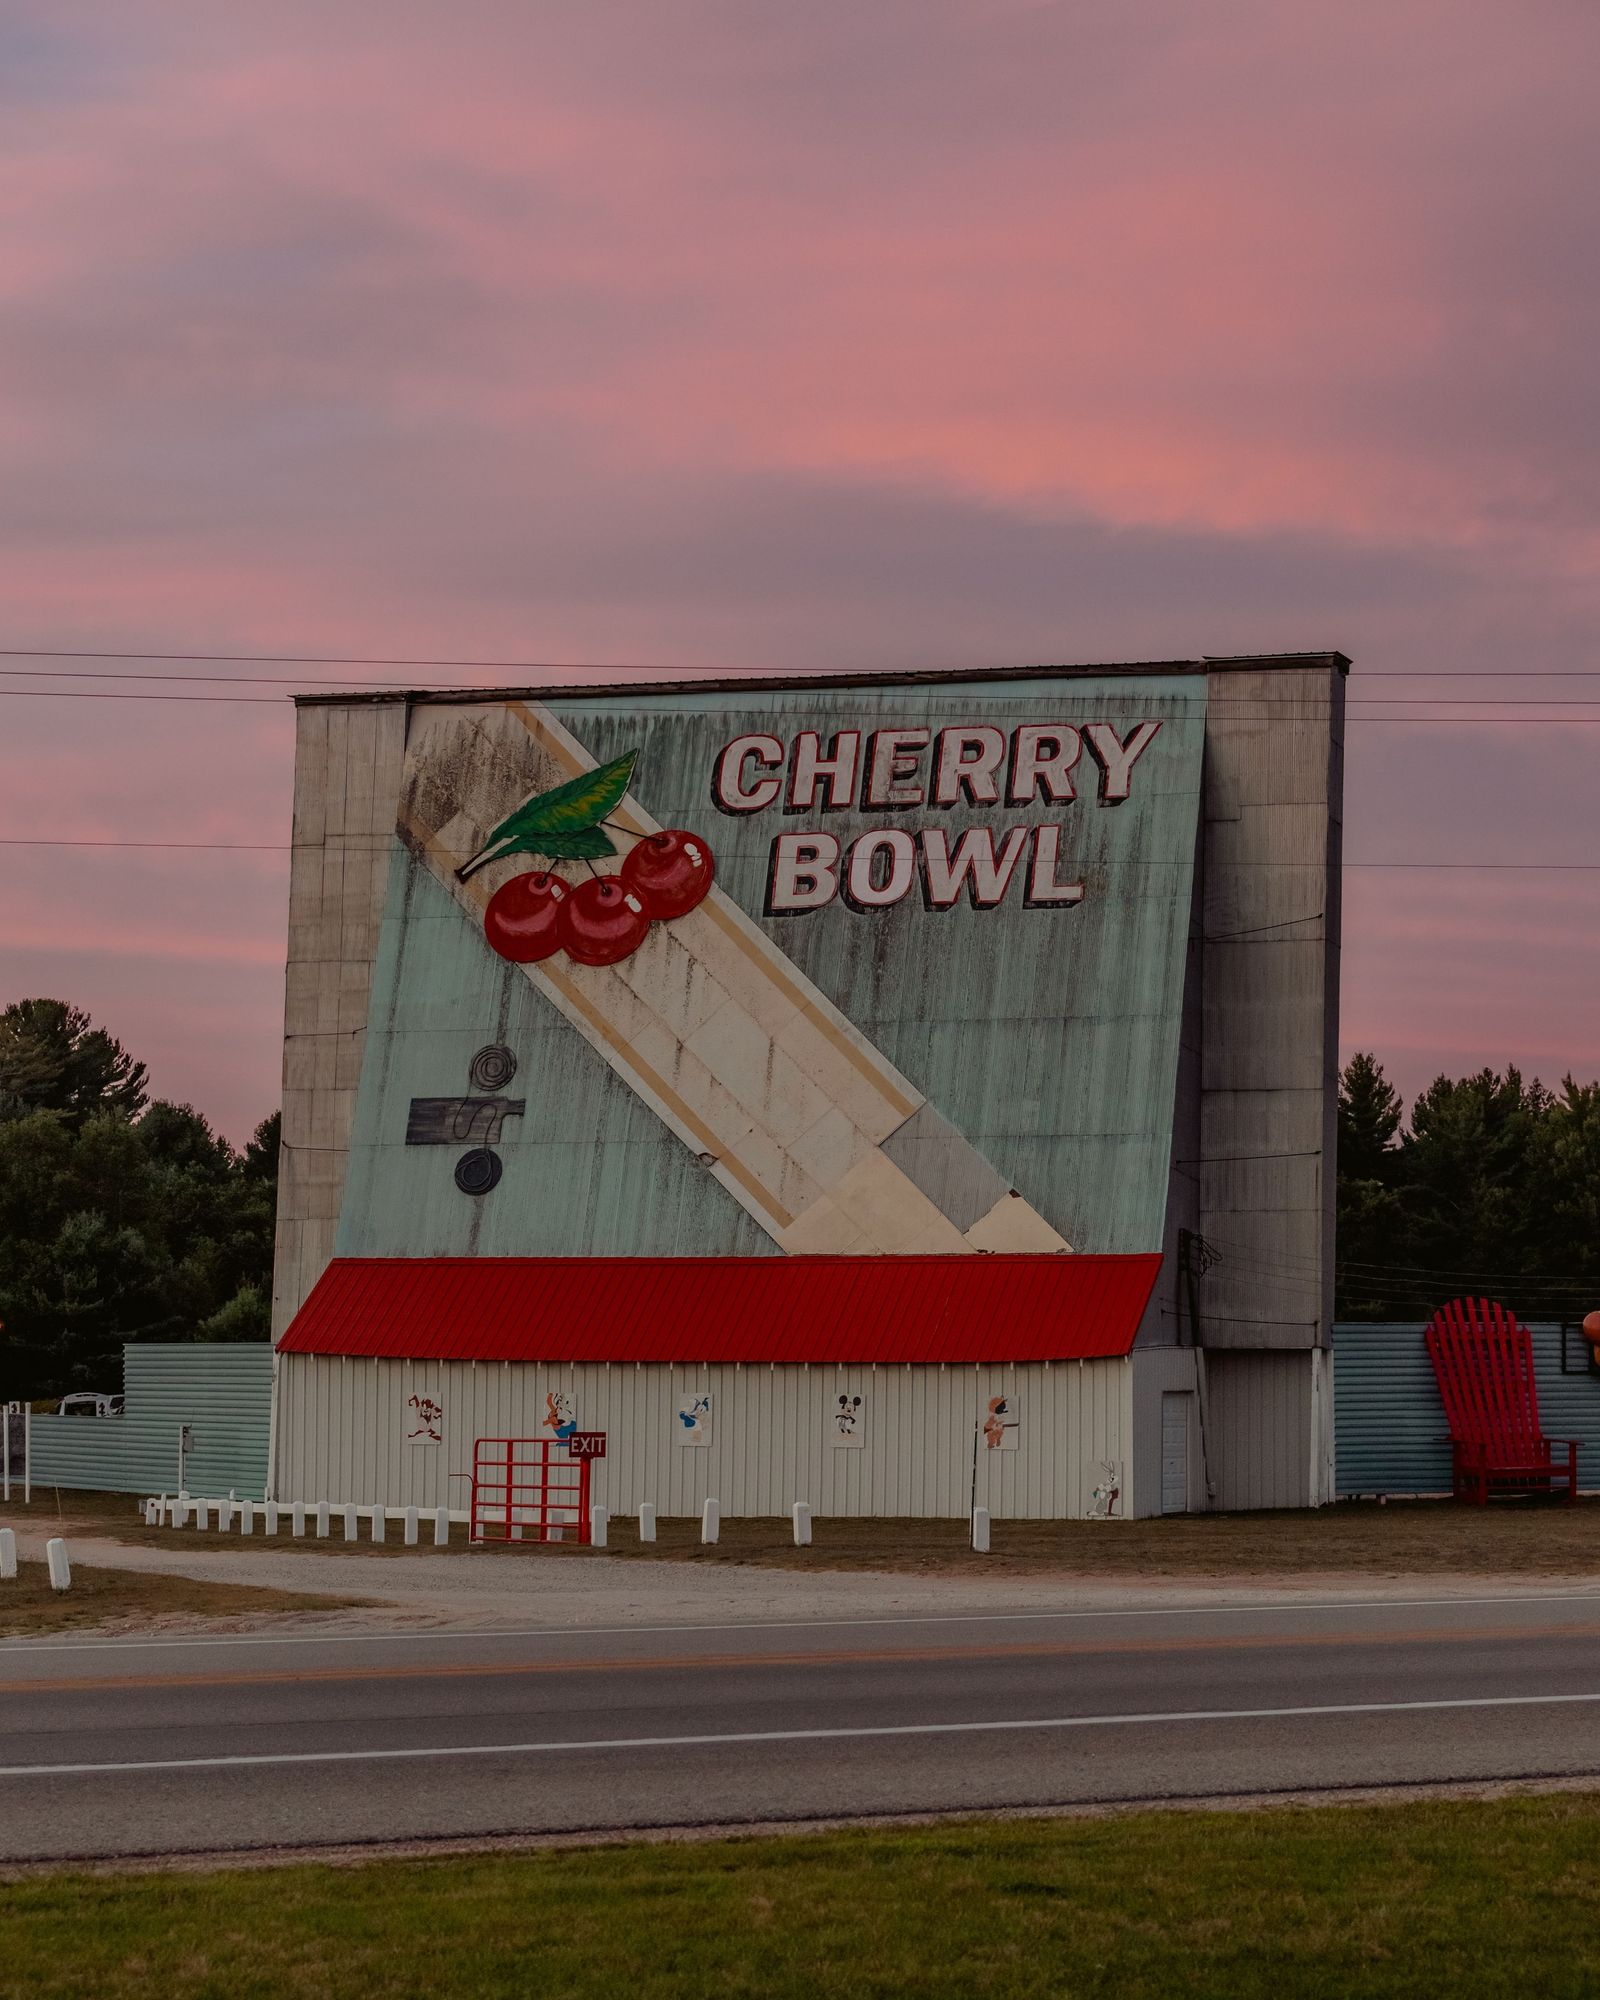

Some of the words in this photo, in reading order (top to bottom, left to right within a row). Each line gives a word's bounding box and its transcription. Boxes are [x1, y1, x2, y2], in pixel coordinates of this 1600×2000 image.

[712, 721, 1163, 815] CHERRY
[764, 824, 1084, 916] BOWL
[571, 1437, 605, 1453] EXIT
